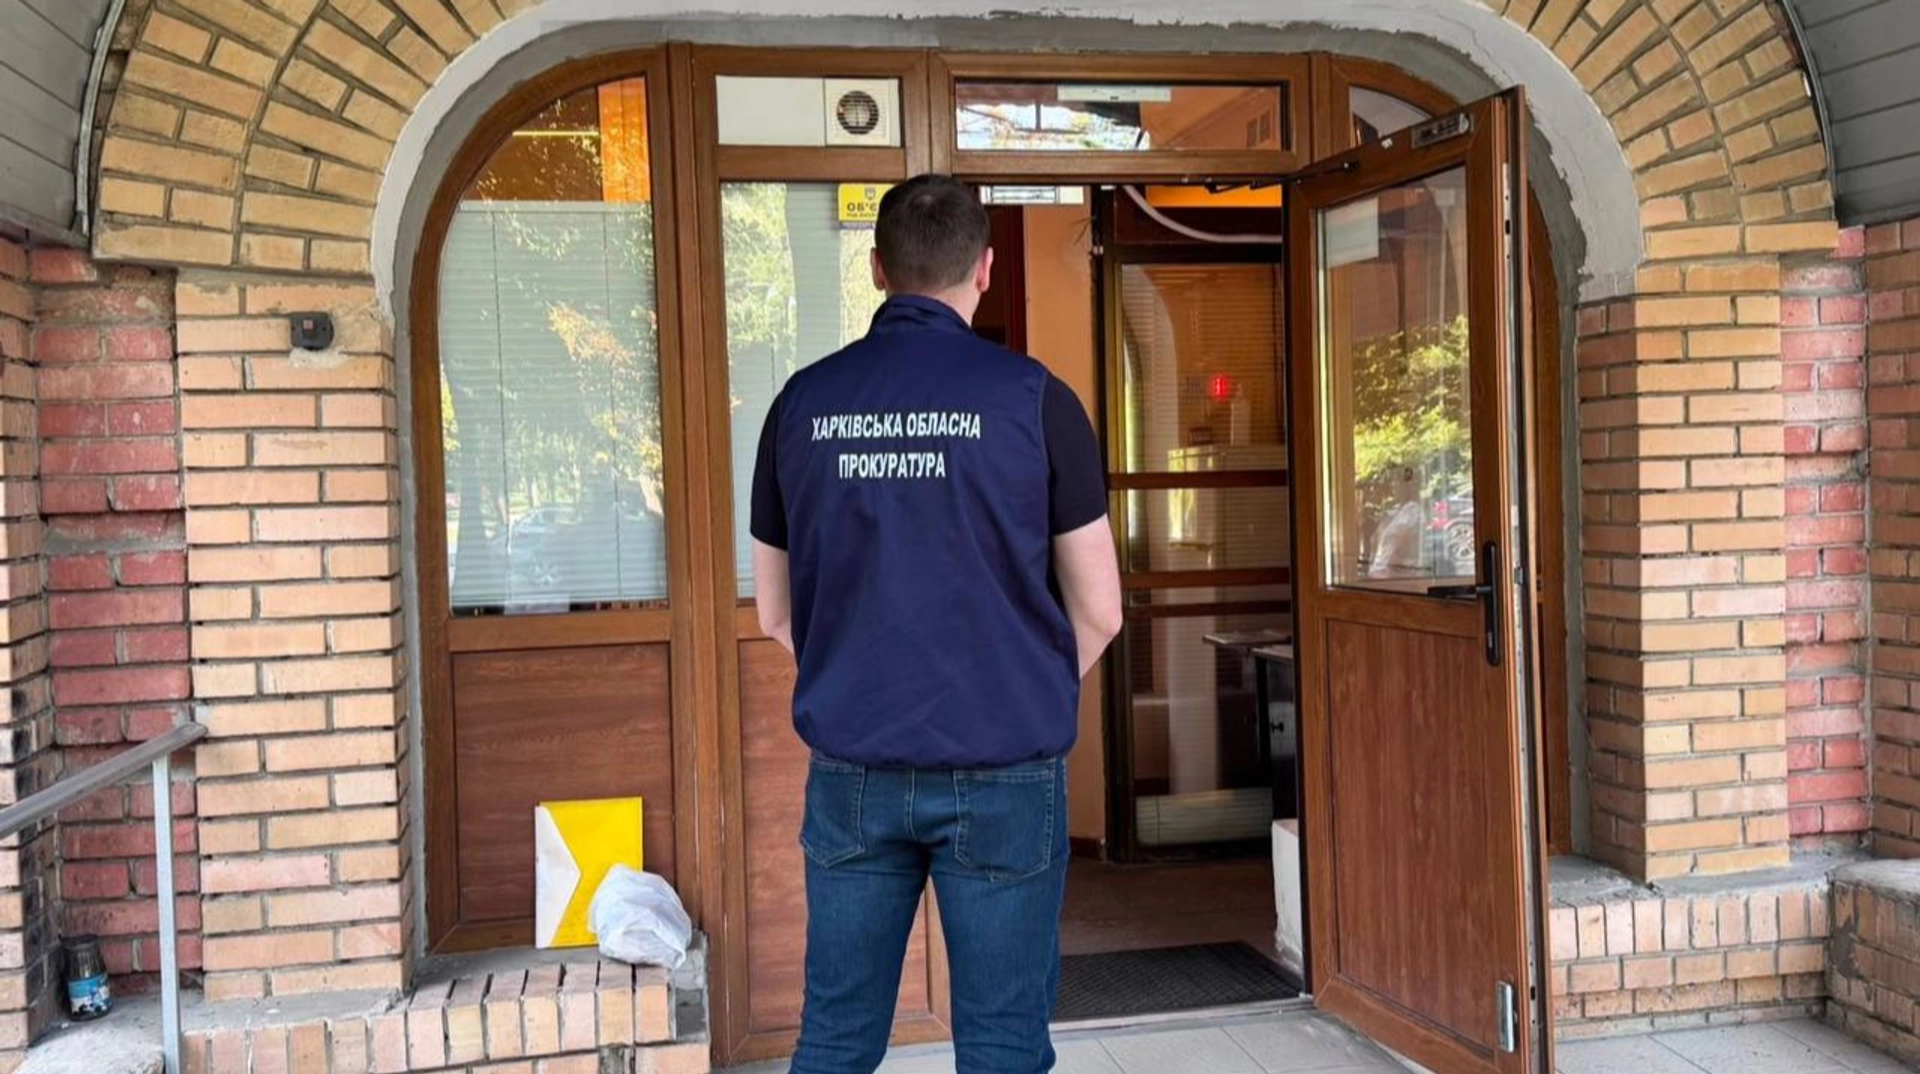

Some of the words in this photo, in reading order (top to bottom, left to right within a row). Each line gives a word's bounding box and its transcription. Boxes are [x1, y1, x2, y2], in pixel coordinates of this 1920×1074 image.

[846, 202, 878, 212] ОБ'Є
[811, 413, 903, 441] ХАРКІВСЬКА
[906, 412, 981, 439] ОБЛАСНА
[838, 452, 946, 478] ПРОКУРАТУРА
